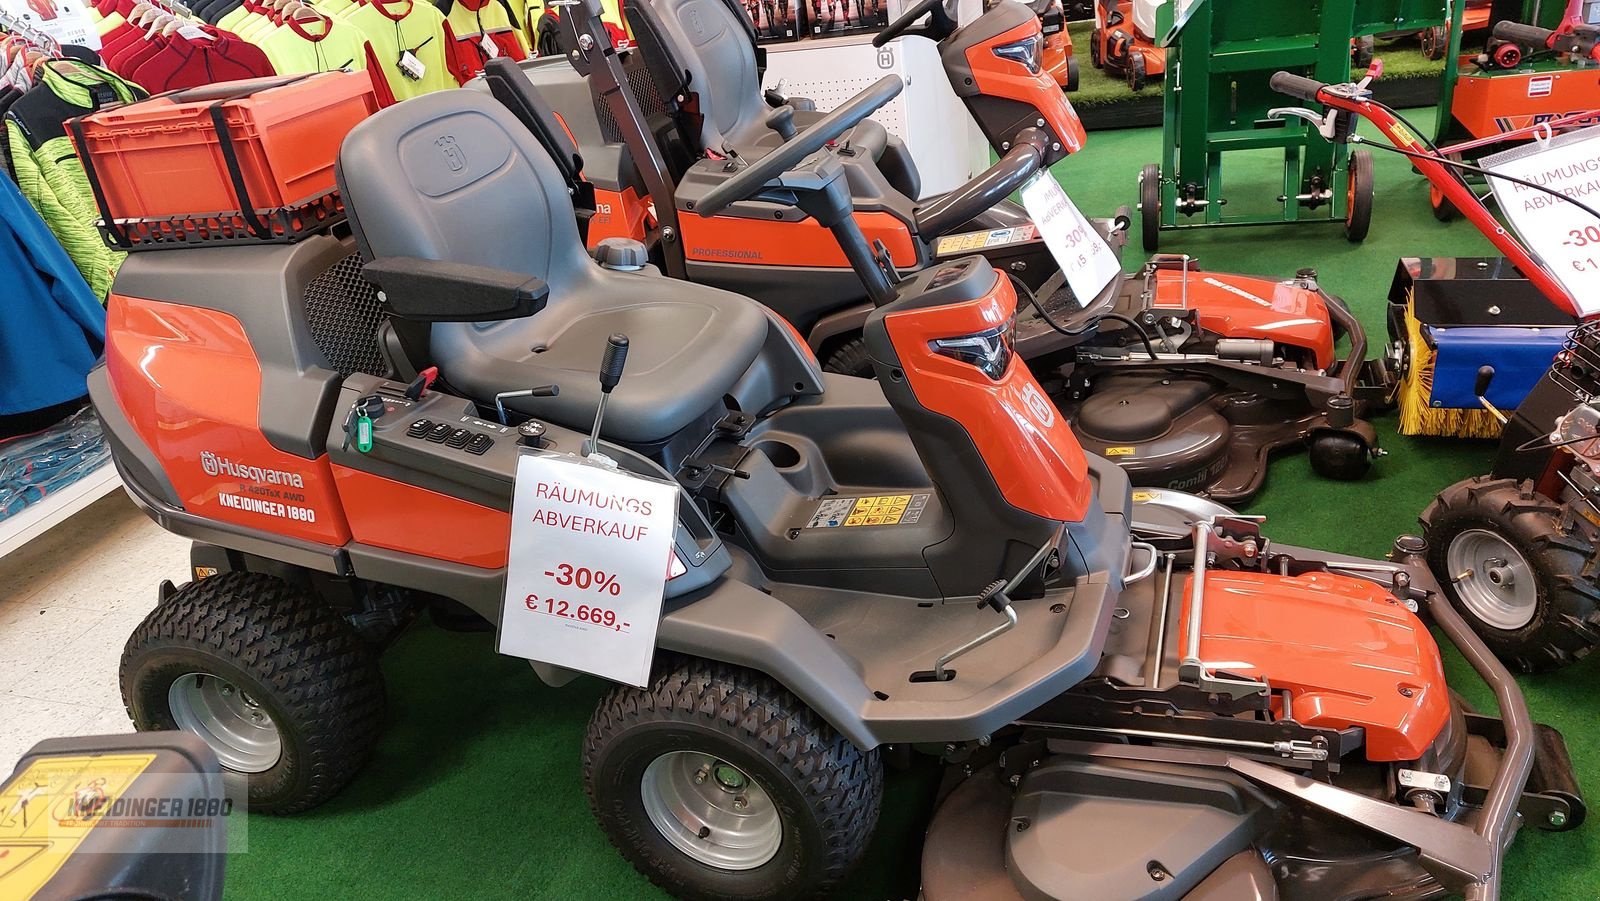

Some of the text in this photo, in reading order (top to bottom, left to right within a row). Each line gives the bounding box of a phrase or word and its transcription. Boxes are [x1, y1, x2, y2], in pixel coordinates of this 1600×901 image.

[596, 203, 612, 214] na
[1562, 225, 1600, 247] -30
[691, 247, 764, 260] PROFESSIONAL
[1572, 260, 1586, 272] €
[217, 457, 304, 489] Husqvarna
[1168, 468, 1208, 490] Combi
[218, 492, 316, 523] KNEIDINGER 1880
[283, 491, 305, 503] AWD
[536, 482, 653, 517] RÄUMUNGS
[532, 508, 649, 542] ABVERKAUF
[544, 563, 621, 597] -30%
[525, 594, 631, 632] € 12.669,-
